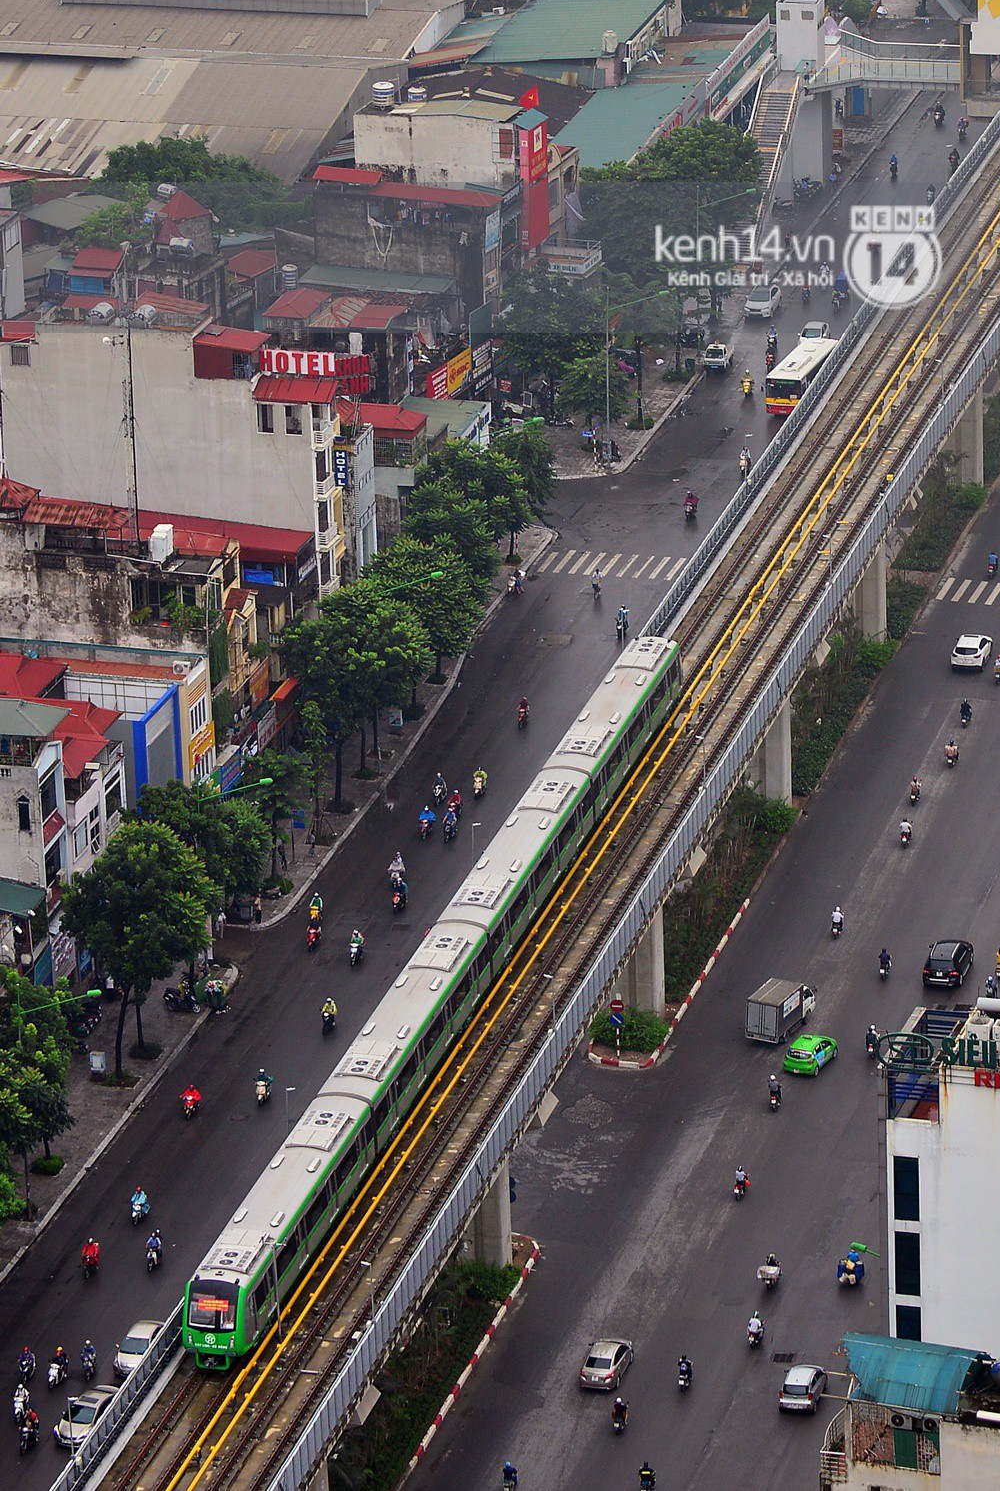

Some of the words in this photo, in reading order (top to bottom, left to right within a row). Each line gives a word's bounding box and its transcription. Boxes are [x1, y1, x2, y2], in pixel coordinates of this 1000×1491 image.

[259, 350, 335, 377] HOTEL
[335, 451, 346, 486] HOTEL
[941, 1033, 997, 1069] SIÊU
